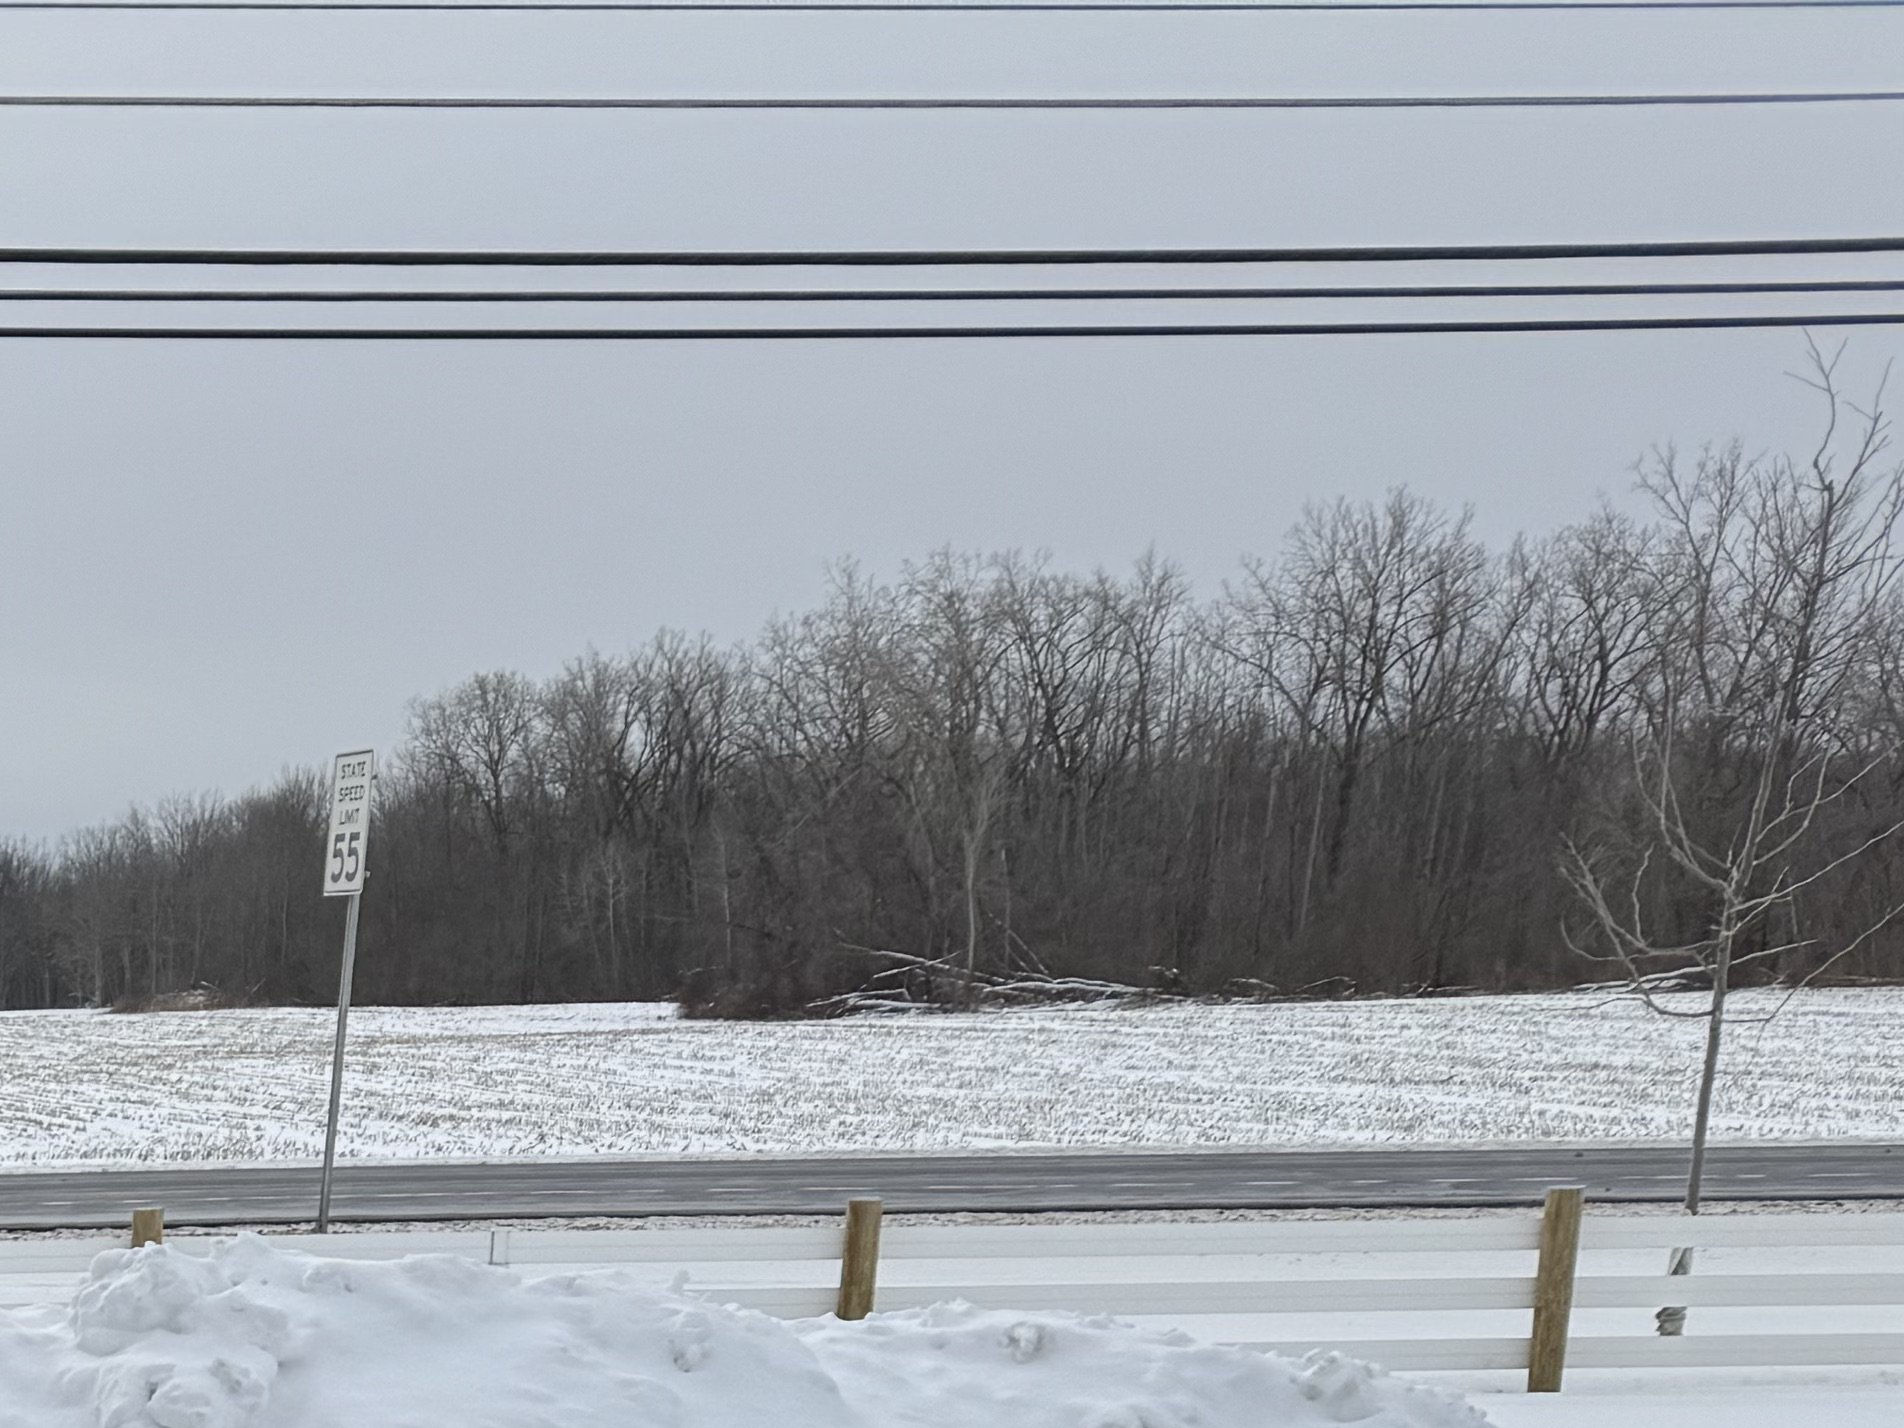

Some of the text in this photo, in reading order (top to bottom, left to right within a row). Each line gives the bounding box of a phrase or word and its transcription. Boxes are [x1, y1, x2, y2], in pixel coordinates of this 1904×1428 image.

[340, 761, 367, 780] STATE
[338, 784, 365, 802] SPEED
[338, 807, 360, 825] LIMIT
[330, 831, 361, 884] 55
